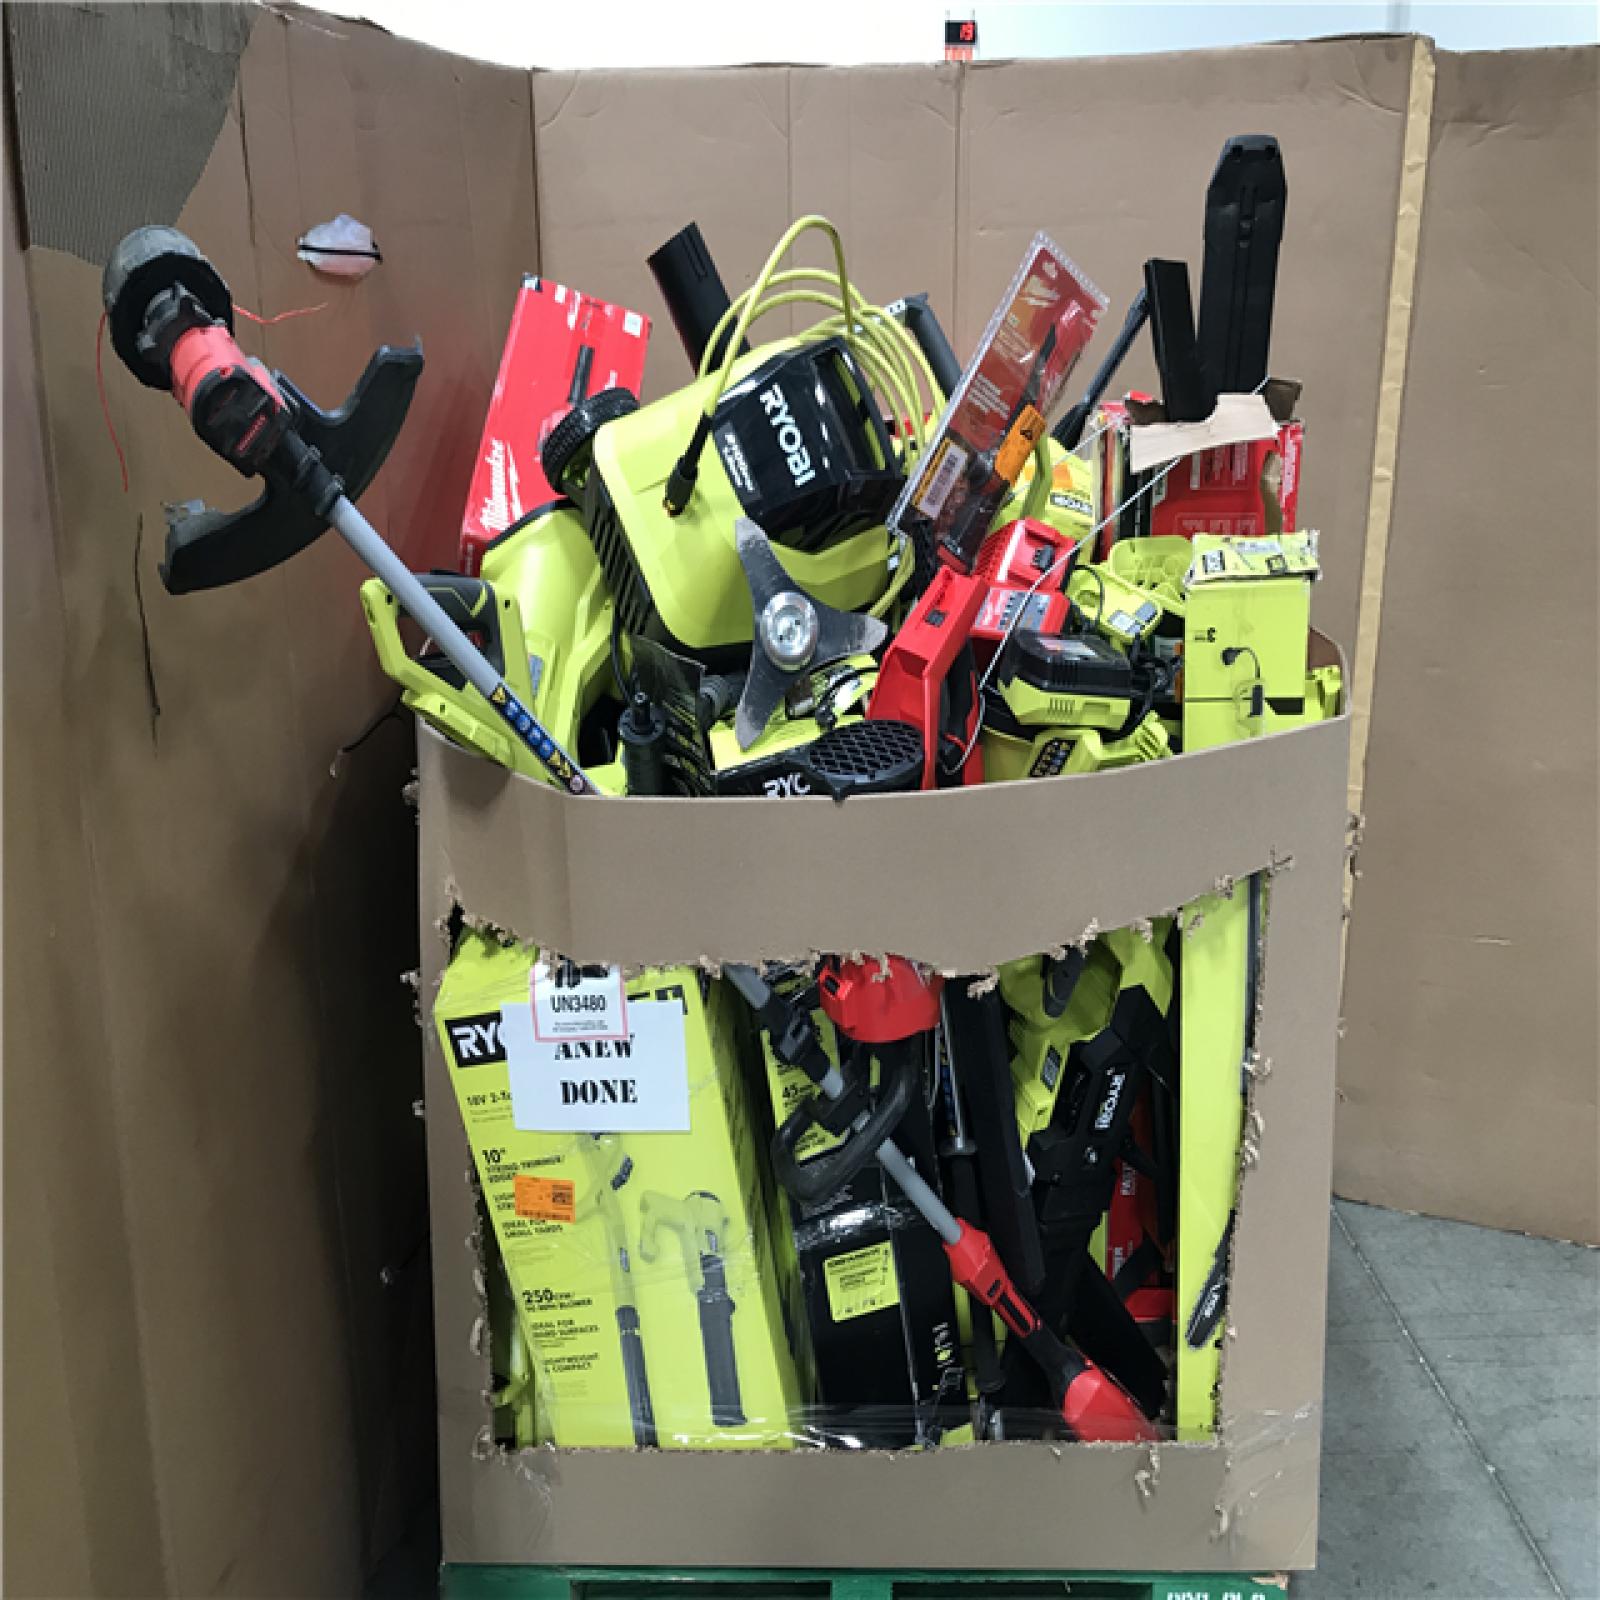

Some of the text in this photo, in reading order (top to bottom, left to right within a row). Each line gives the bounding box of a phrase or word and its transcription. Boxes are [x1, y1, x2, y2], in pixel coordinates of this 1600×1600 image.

[760, 383, 816, 487] RYOBI
[480, 438, 512, 532] Milwaukee
[551, 994, 607, 1013] UN3480
[452, 1021, 504, 1058] RY
[554, 1034, 636, 1061] ANEW
[560, 1079, 638, 1106] DONE
